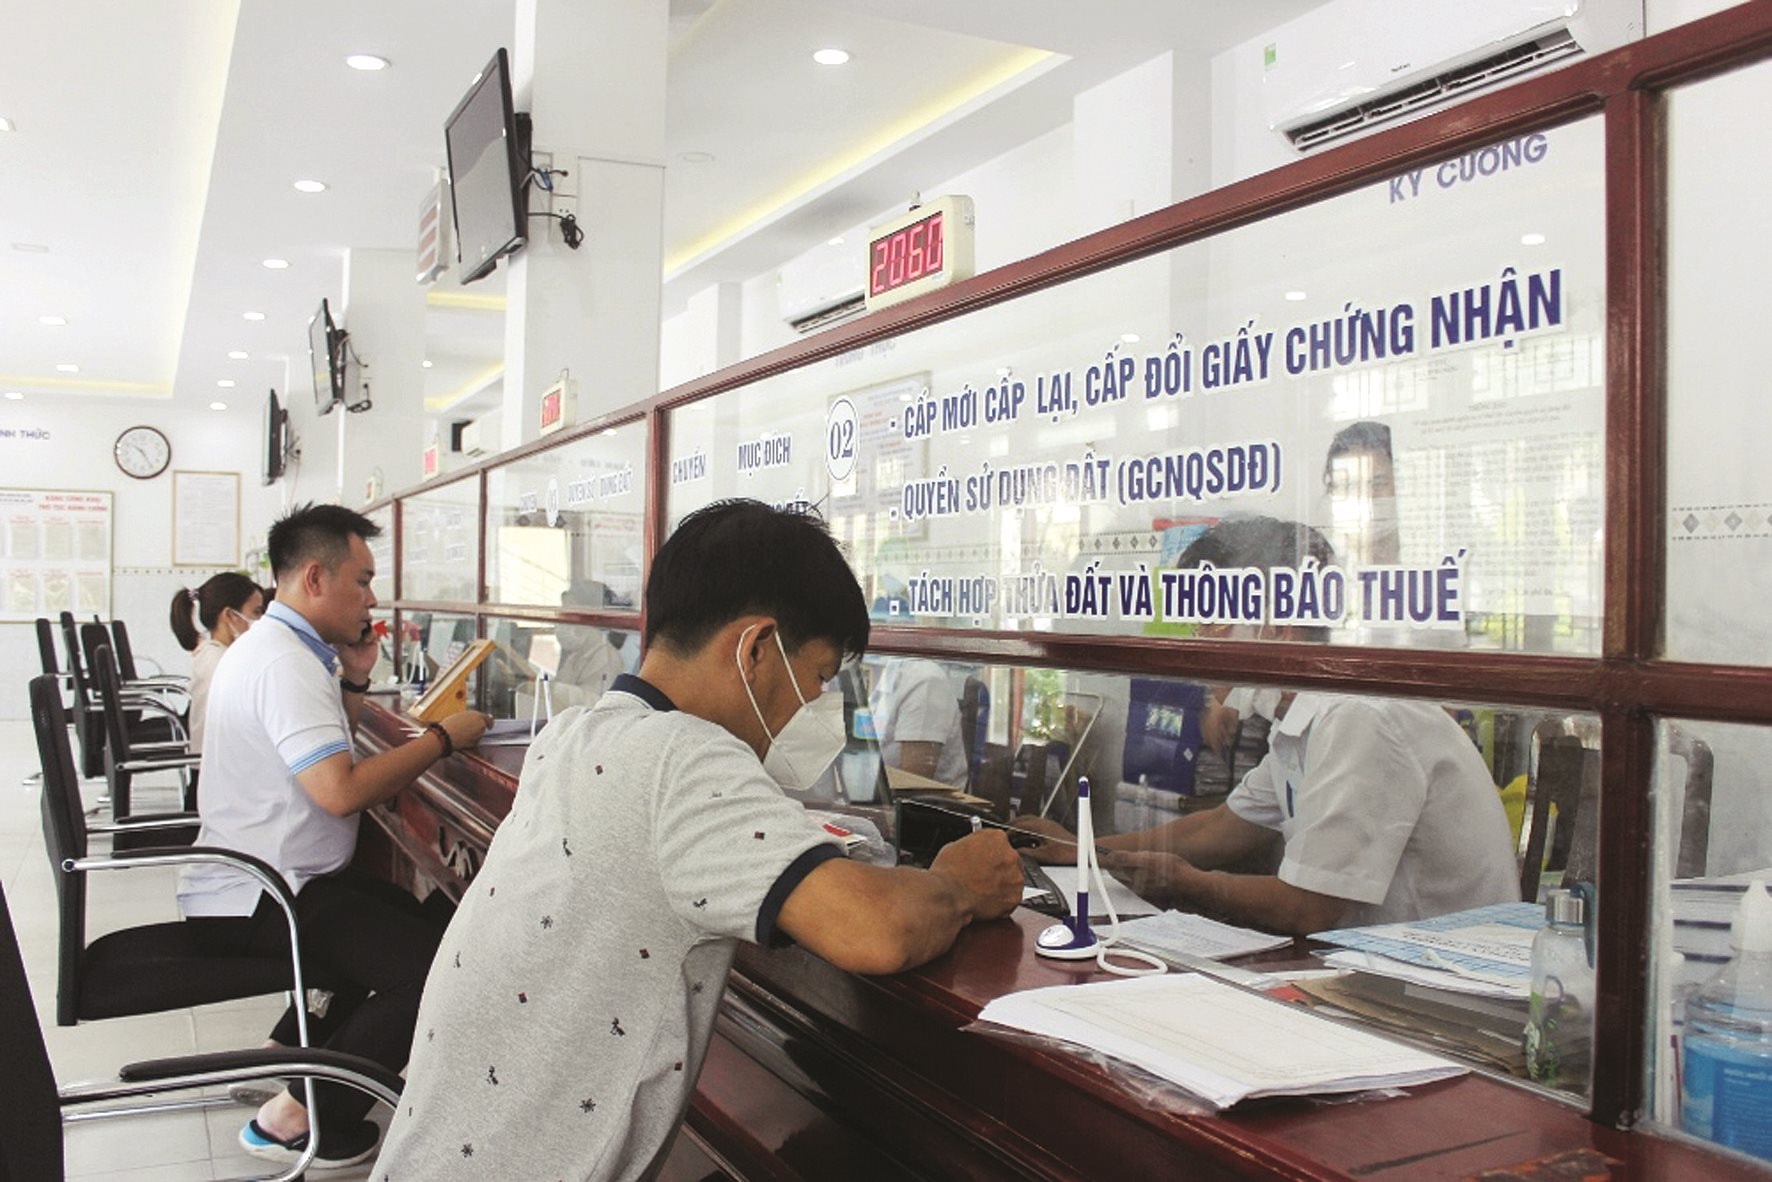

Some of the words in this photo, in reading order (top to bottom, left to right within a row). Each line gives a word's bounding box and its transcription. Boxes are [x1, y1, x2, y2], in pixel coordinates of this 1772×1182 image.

[873, 216, 943, 293] 2060
[904, 387, 937, 438] CẤP
[942, 384, 978, 431] MỚI
[985, 366, 1025, 423] CẤP
[1037, 371, 1078, 423] LẠI,
[1086, 344, 1135, 406] CẤP
[1144, 332, 1191, 399] ĐỔI
[1202, 319, 1273, 389] GIẤY
[1285, 301, 1414, 375] CHỨNG
[1431, 266, 1561, 349] NHẬN
[738, 442, 761, 477] MỤC
[830, 420, 853, 460] 02
[904, 465, 960, 520] QUYỀN
[967, 462, 993, 512] SỬ
[999, 465, 1057, 513] DỤNG
[1118, 442, 1281, 506] (GCNQSDĐ)
[909, 572, 953, 613] TÁCH
[959, 576, 997, 625] HỢP
[1002, 562, 1059, 614] THỬA
[1065, 561, 1112, 616] ĐẤT
[1119, 565, 1153, 616] VÀ
[1161, 564, 1262, 620] THÔNG
[1273, 560, 1345, 620] BÁO
[1357, 548, 1467, 623] THUẾ
